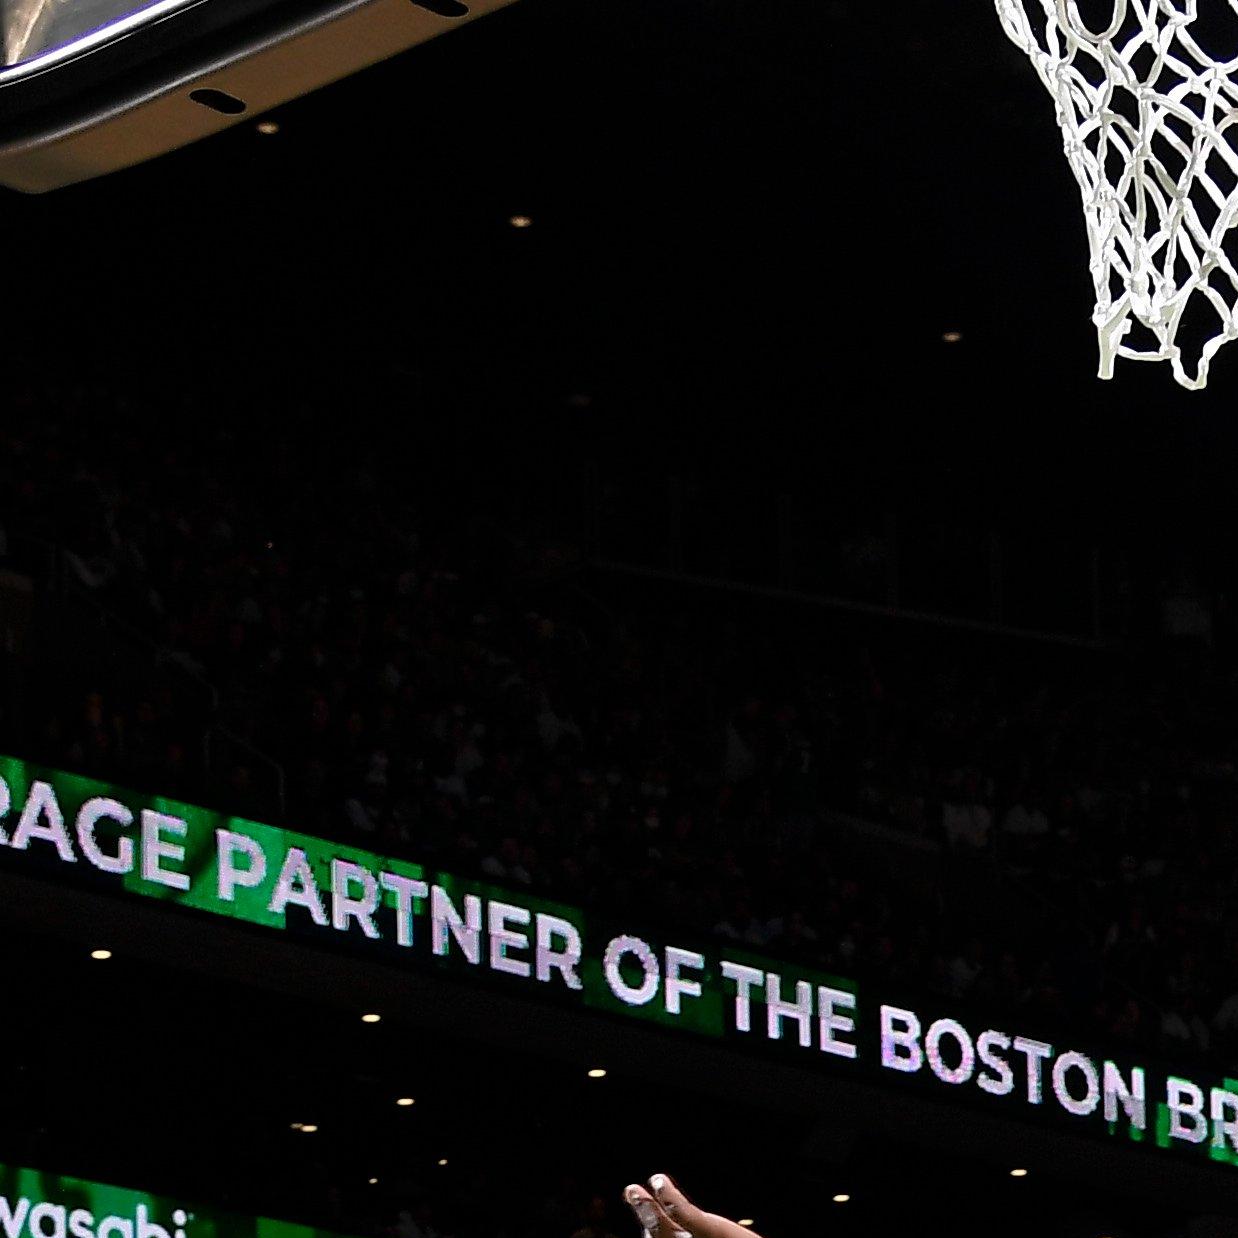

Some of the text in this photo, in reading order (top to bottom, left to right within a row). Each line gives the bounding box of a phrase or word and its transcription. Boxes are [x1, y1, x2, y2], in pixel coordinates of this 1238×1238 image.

[215, 828, 583, 990] PARTNER
[604, 935, 706, 1015] OF
[720, 960, 857, 1059] THE
[880, 1004, 1146, 1130] BOSTON
